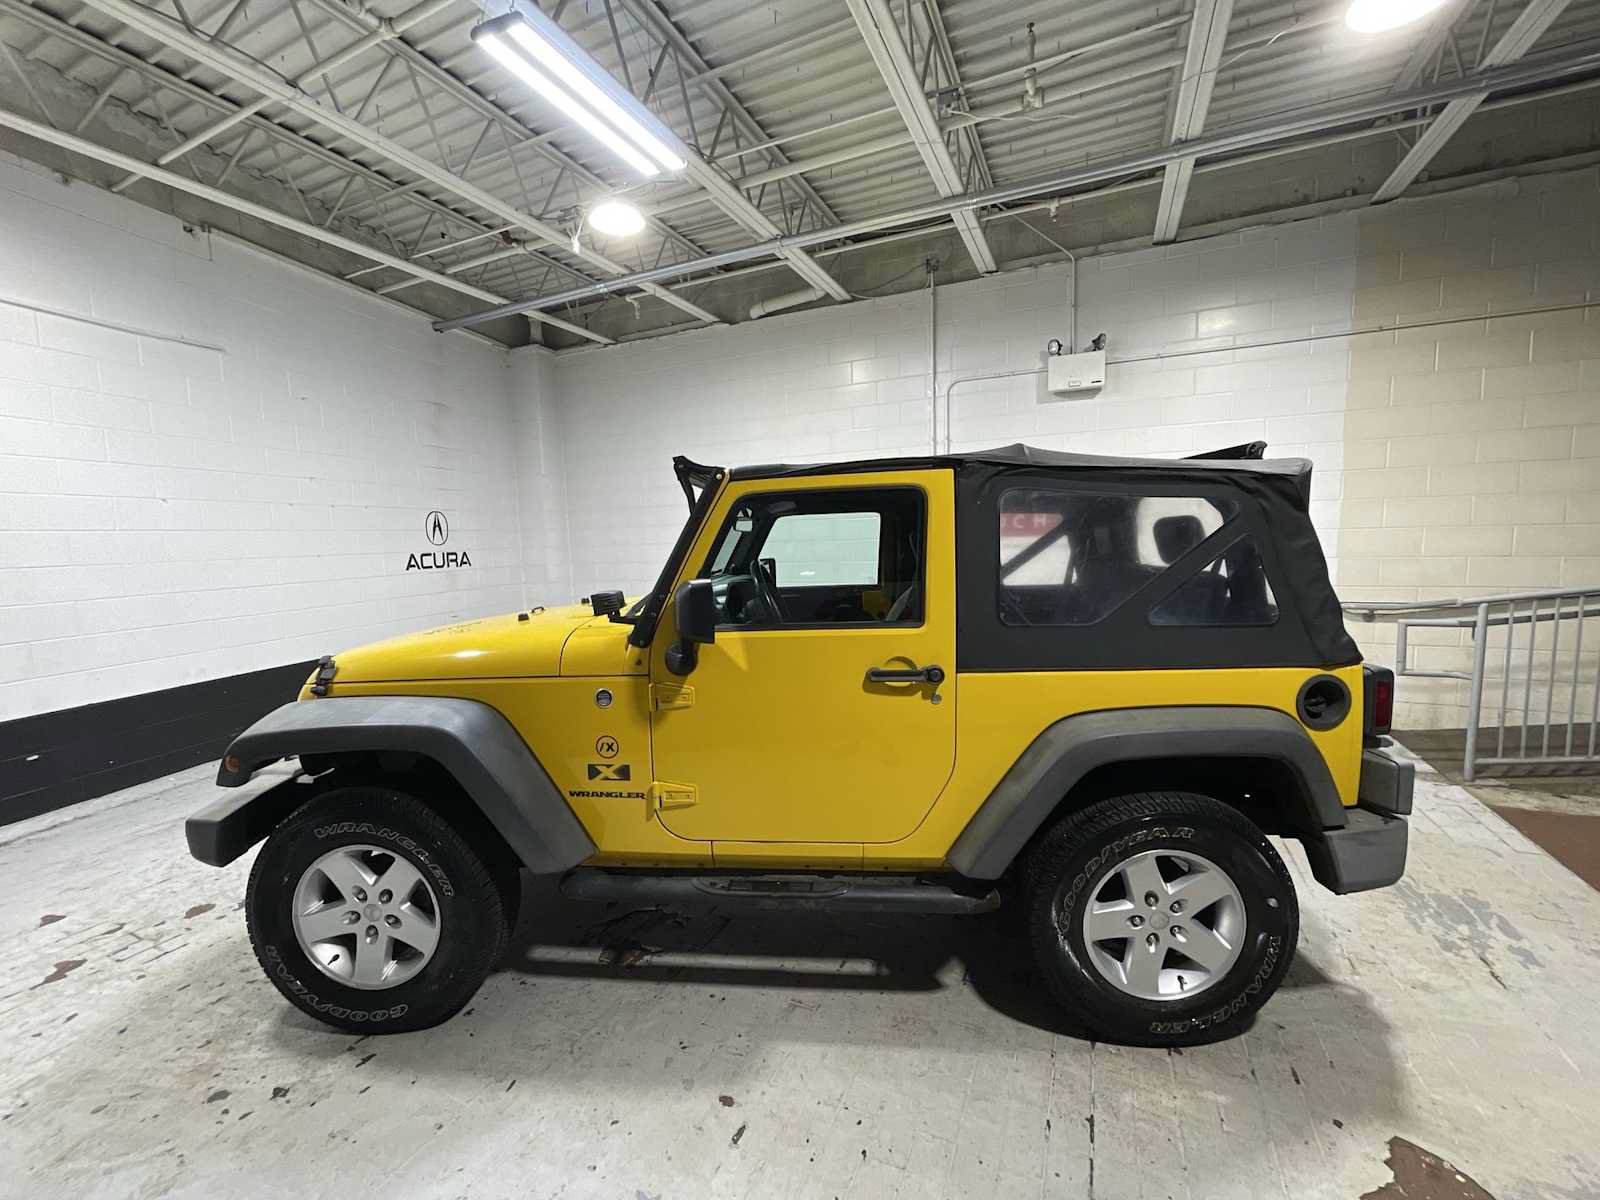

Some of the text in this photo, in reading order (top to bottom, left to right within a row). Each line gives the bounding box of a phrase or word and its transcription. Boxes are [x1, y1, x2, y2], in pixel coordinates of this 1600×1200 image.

[406, 552, 472, 571] ACURA
[569, 790, 647, 799] WRANGLER
[313, 821, 455, 898] WRANGLER
[1057, 826, 1196, 933] GOODYEAR
[265, 944, 409, 1023] GOODYEAR
[1148, 935, 1282, 1034] WRANGLER
